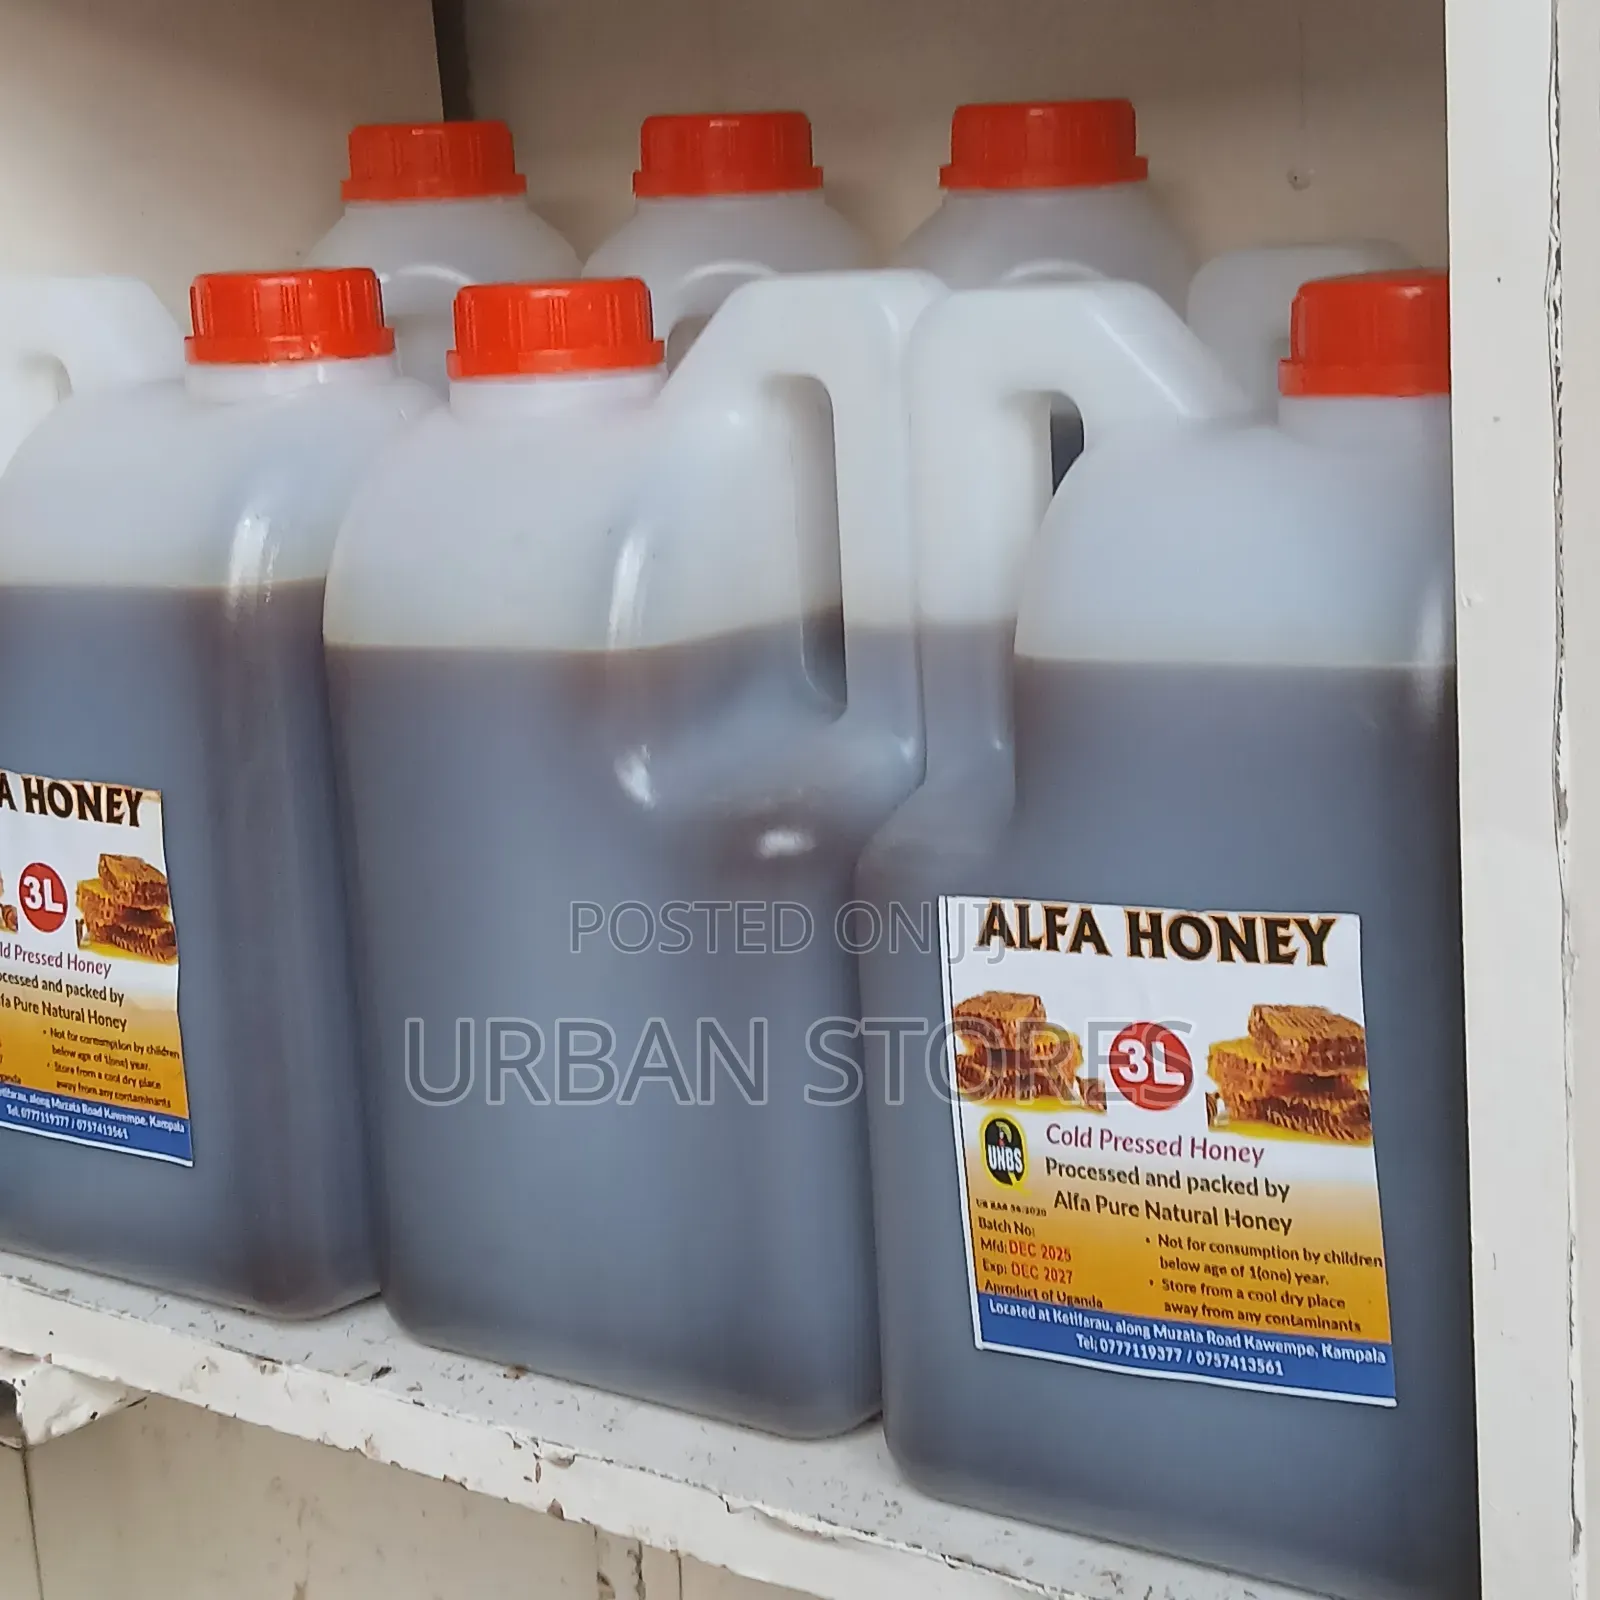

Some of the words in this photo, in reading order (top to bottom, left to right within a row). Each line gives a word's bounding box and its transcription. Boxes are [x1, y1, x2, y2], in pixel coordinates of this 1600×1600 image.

[21, 775, 144, 829] HONEY
[23, 875, 64, 914] 3L
[978, 898, 1113, 957] ALFA
[1123, 906, 1337, 967] HONEY
[14, 944, 63, 968] Pressed
[67, 952, 112, 980] Honey
[41, 979, 63, 994] and
[66, 983, 107, 1002] packed
[109, 987, 125, 1008] by
[14, 996, 39, 1015] Pure
[42, 1000, 85, 1024] Natural
[88, 1009, 127, 1033] Honey
[50, 1027, 66, 1040] Not
[67, 1030, 79, 1042] for
[133, 1041, 145, 1056] by
[146, 1045, 180, 1060] children
[52, 1044, 76, 1058] below
[94, 1052, 103, 1063] of
[76, 1065, 96, 1079] from
[122, 1074, 137, 1089] dry
[138, 1077, 162, 1090] place
[1114, 1038, 1186, 1087] 3L
[98, 1087, 114, 1100] any
[987, 1143, 1024, 1174] UNBS
[1045, 1122, 1093, 1149] Cold
[1099, 1127, 1182, 1158] Pressed
[1190, 1135, 1265, 1168] Honey
[1044, 1156, 1140, 1187] Processed
[1146, 1169, 1181, 1190] and
[1186, 1173, 1259, 1197] packed
[1264, 1176, 1291, 1203] by
[978, 1215, 1013, 1235] Batch
[1053, 1189, 1091, 1213] Alfa
[1095, 1194, 1140, 1218] Pure
[1145, 1199, 1219, 1227] Natural
[1225, 1207, 1293, 1236] Honey
[1008, 1239, 1037, 1258] DEC
[1041, 1243, 1072, 1263] 2025
[1158, 1233, 1184, 1250] Not
[1186, 1236, 1207, 1252] for
[1209, 1241, 1300, 1261] consumption
[1302, 1247, 1321, 1265] by
[1323, 1249, 1384, 1269] children
[1011, 1260, 1040, 1281] DEC
[1043, 1265, 1074, 1285] 2027
[1159, 1255, 1201, 1273] below
[1203, 1263, 1228, 1279] age
[1230, 1265, 1246, 1278] of
[1249, 1264, 1292, 1285] 1(one)
[1041, 1288, 1055, 1303] of
[1056, 1290, 1104, 1309] Uganda
[1161, 1277, 1197, 1295] Store
[1200, 1282, 1233, 1300] from
[1236, 1288, 1245, 1300] a
[1247, 1289, 1278, 1304] cool
[1280, 1290, 1304, 1308] dry
[1307, 1293, 1346, 1309] place
[988, 1297, 1037, 1321] Located
[1038, 1306, 1052, 1324] at
[1115, 1318, 1151, 1341] along
[1206, 1328, 1242, 1350] Road
[1243, 1333, 1320, 1360] Kawempe,
[1320, 1341, 1387, 1366] Kampala
[1164, 1301, 1199, 1318] away
[1201, 1302, 1235, 1321] from
[1237, 1310, 1262, 1326] any
[1265, 1313, 1362, 1333] contaminants
